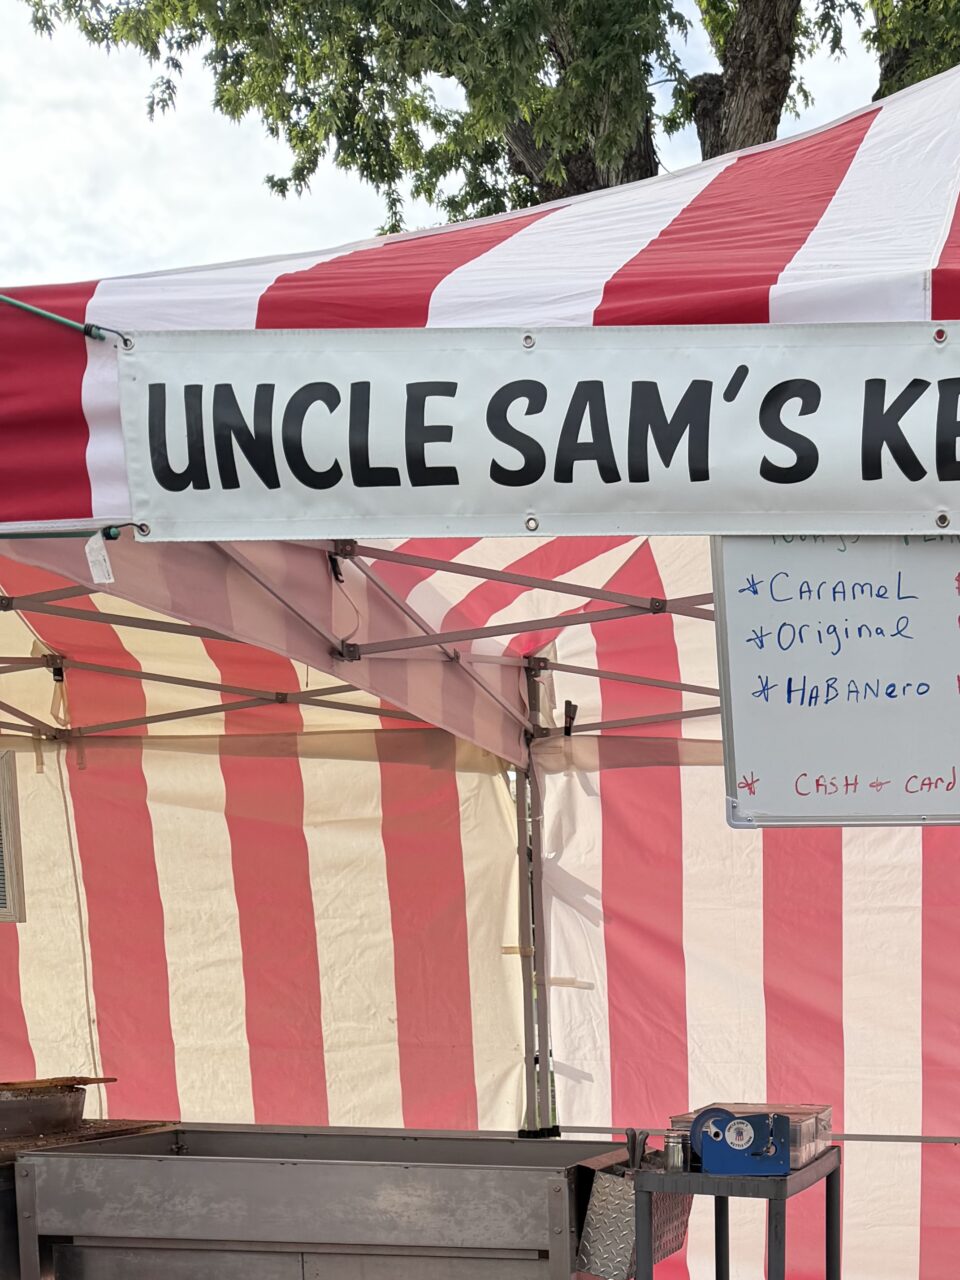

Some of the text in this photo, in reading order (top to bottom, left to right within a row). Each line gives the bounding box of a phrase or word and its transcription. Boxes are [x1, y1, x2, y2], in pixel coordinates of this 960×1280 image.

[148, 381, 460, 492] UNCLE
[486, 365, 822, 486] SAM'S
[777, 615, 914, 656] Original
[795, 773, 859, 796] CASH
